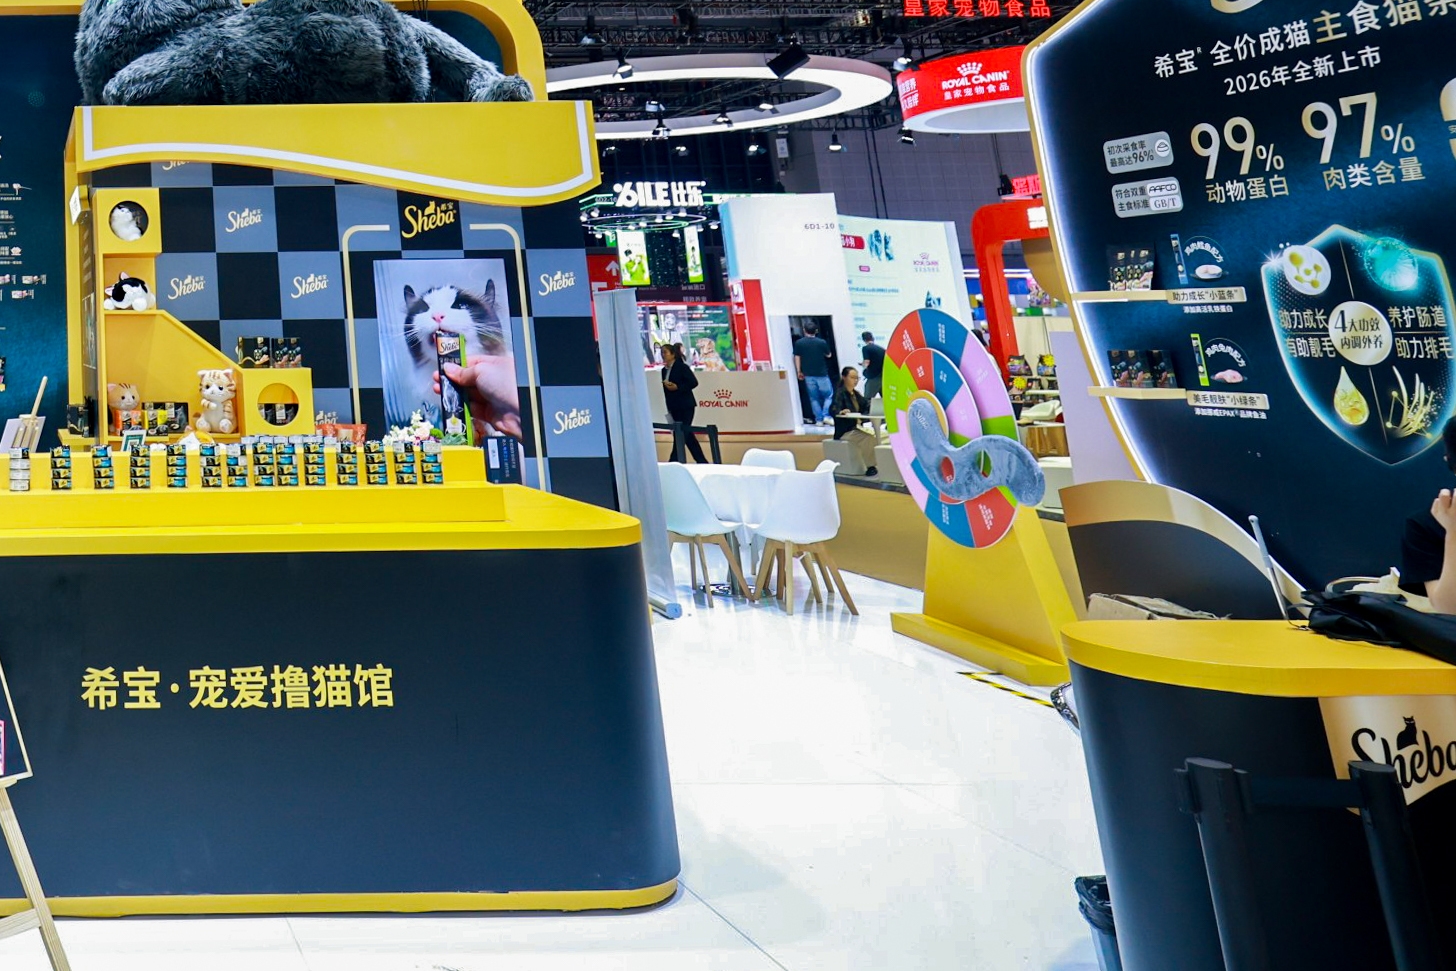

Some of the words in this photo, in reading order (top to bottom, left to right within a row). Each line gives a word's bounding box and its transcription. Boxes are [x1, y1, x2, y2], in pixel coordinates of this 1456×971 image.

[941, 76, 971, 90] ROYAL
[972, 70, 1008, 84] CANIN
[1223, 46, 1382, 96] 2026年全新上市
[944, 82, 1010, 101] 皇家宠物食品
[1190, 116, 1285, 181] 99%
[1301, 91, 1416, 165] 97%
[1322, 156, 1427, 191] 肉类含量
[1205, 174, 1290, 205] 动物蛋白
[1153, 197, 1177, 209] GB/T
[225, 210, 263, 233] Sheba
[401, 204, 456, 239] Sheba
[167, 277, 205, 301] Sheba
[290, 275, 328, 299] Sheba
[539, 273, 575, 296] Sheba
[1279, 307, 1328, 329] 助力成长
[1333, 308, 1381, 334] 4大功效
[1387, 306, 1448, 329] 养护肠道
[1286, 336, 1336, 359] 有助靓毛
[1339, 334, 1384, 351] 内调外养
[1395, 336, 1454, 360] 助力排毛
[553, 411, 591, 435] Sheba
[81, 663, 395, 711] 希宝·宠爱撸猫馆
